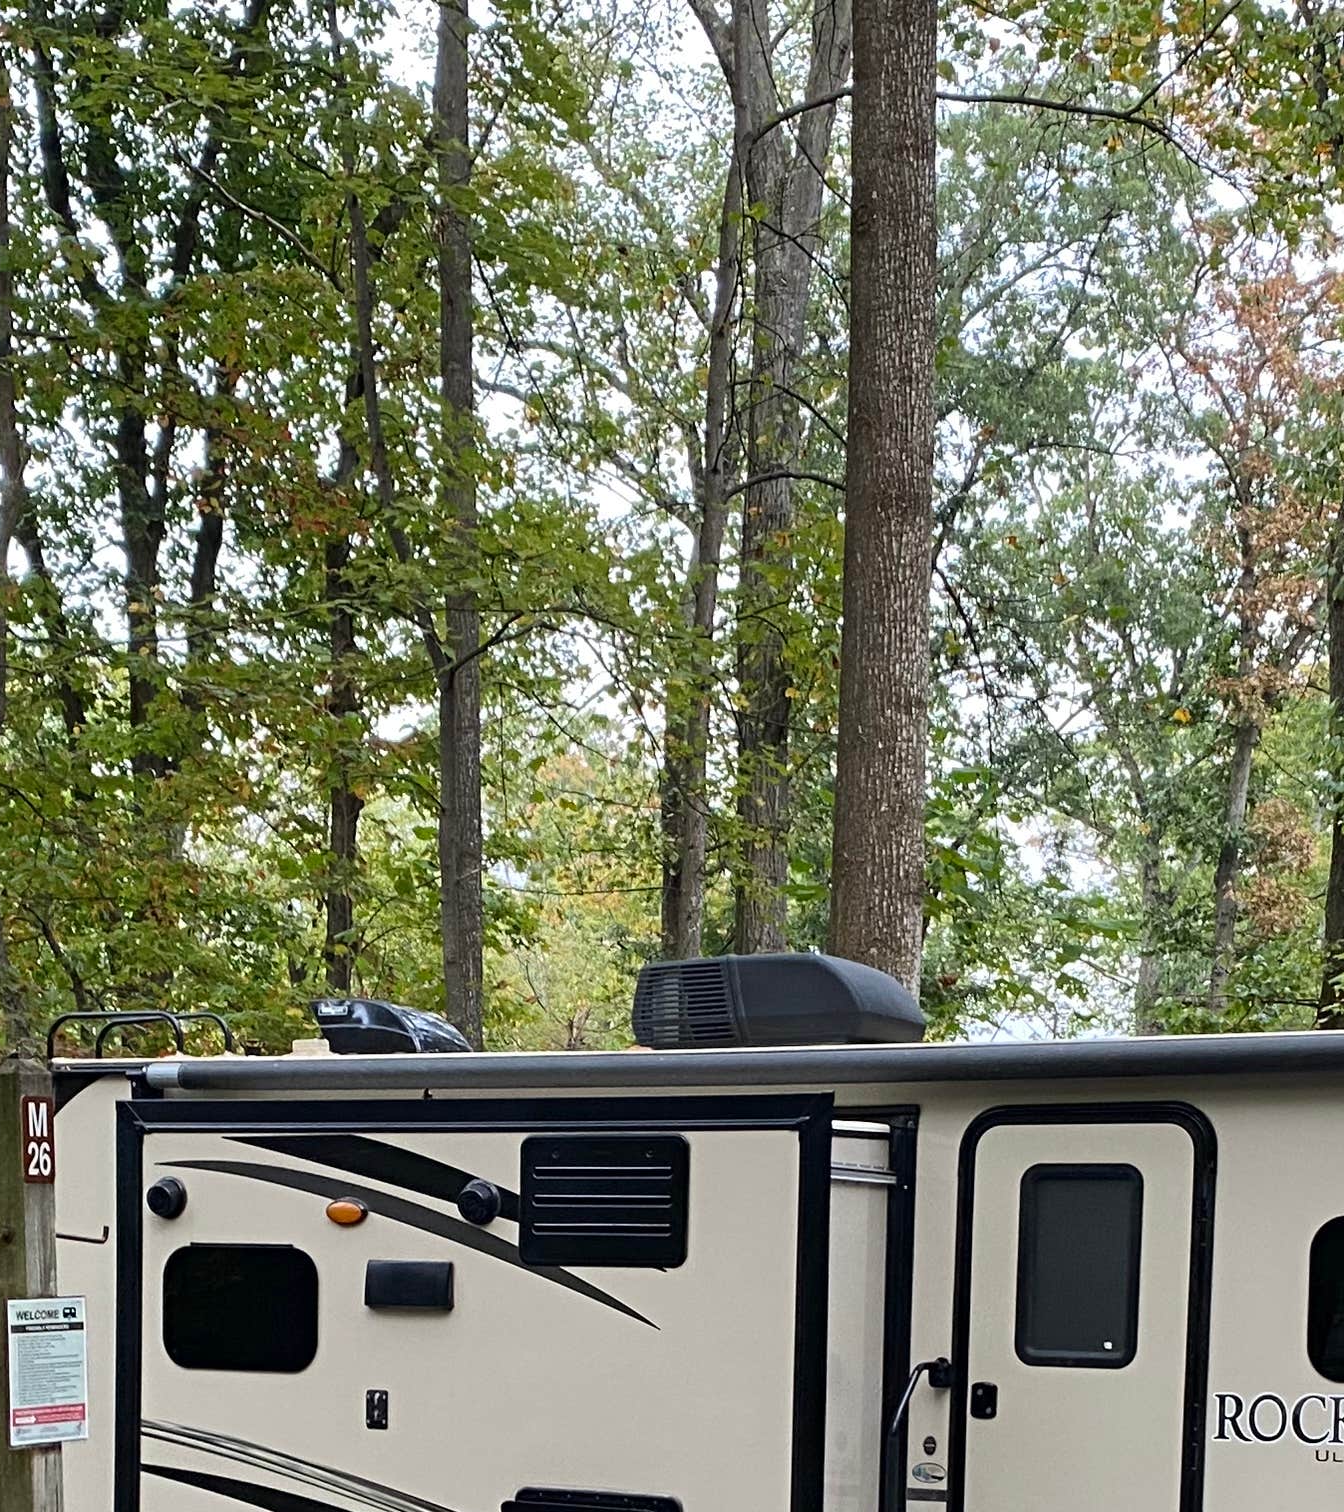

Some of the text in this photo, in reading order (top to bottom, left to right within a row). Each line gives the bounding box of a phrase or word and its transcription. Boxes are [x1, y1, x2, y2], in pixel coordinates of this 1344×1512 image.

[28, 1102, 48, 1137] M
[27, 1141, 51, 1176] 26
[16, 1309, 59, 1321] WELCOME
